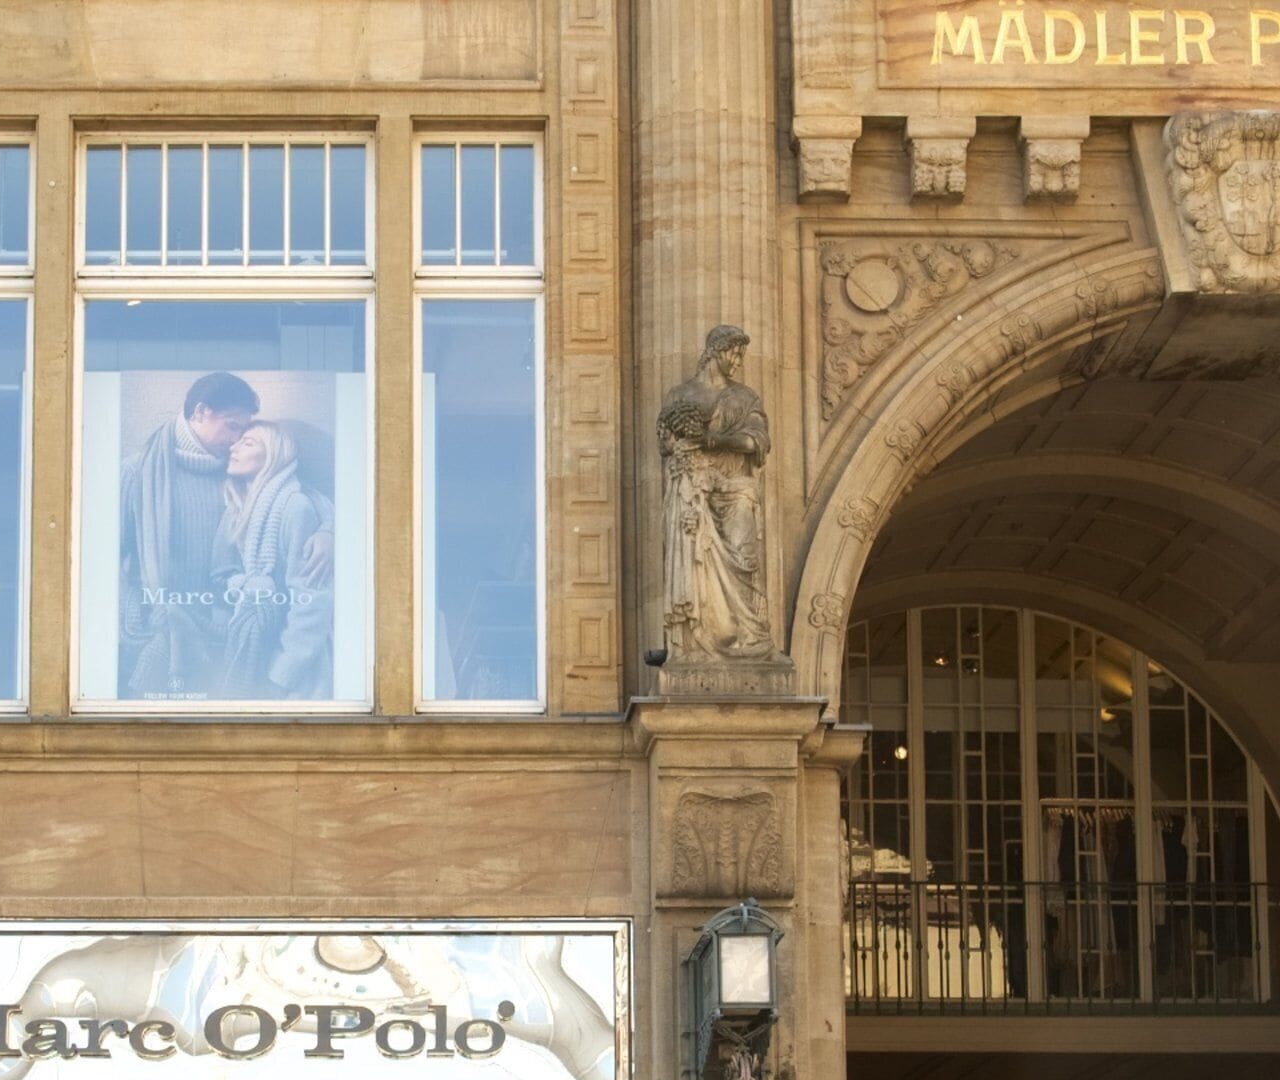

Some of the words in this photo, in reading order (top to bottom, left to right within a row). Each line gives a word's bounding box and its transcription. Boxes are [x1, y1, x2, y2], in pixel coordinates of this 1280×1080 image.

[930, 0, 1219, 66] MÄDLER
[141, 587, 214, 606] Marc
[223, 587, 312, 606] O'Polo
[204, 1000, 515, 1061] O'Polo
